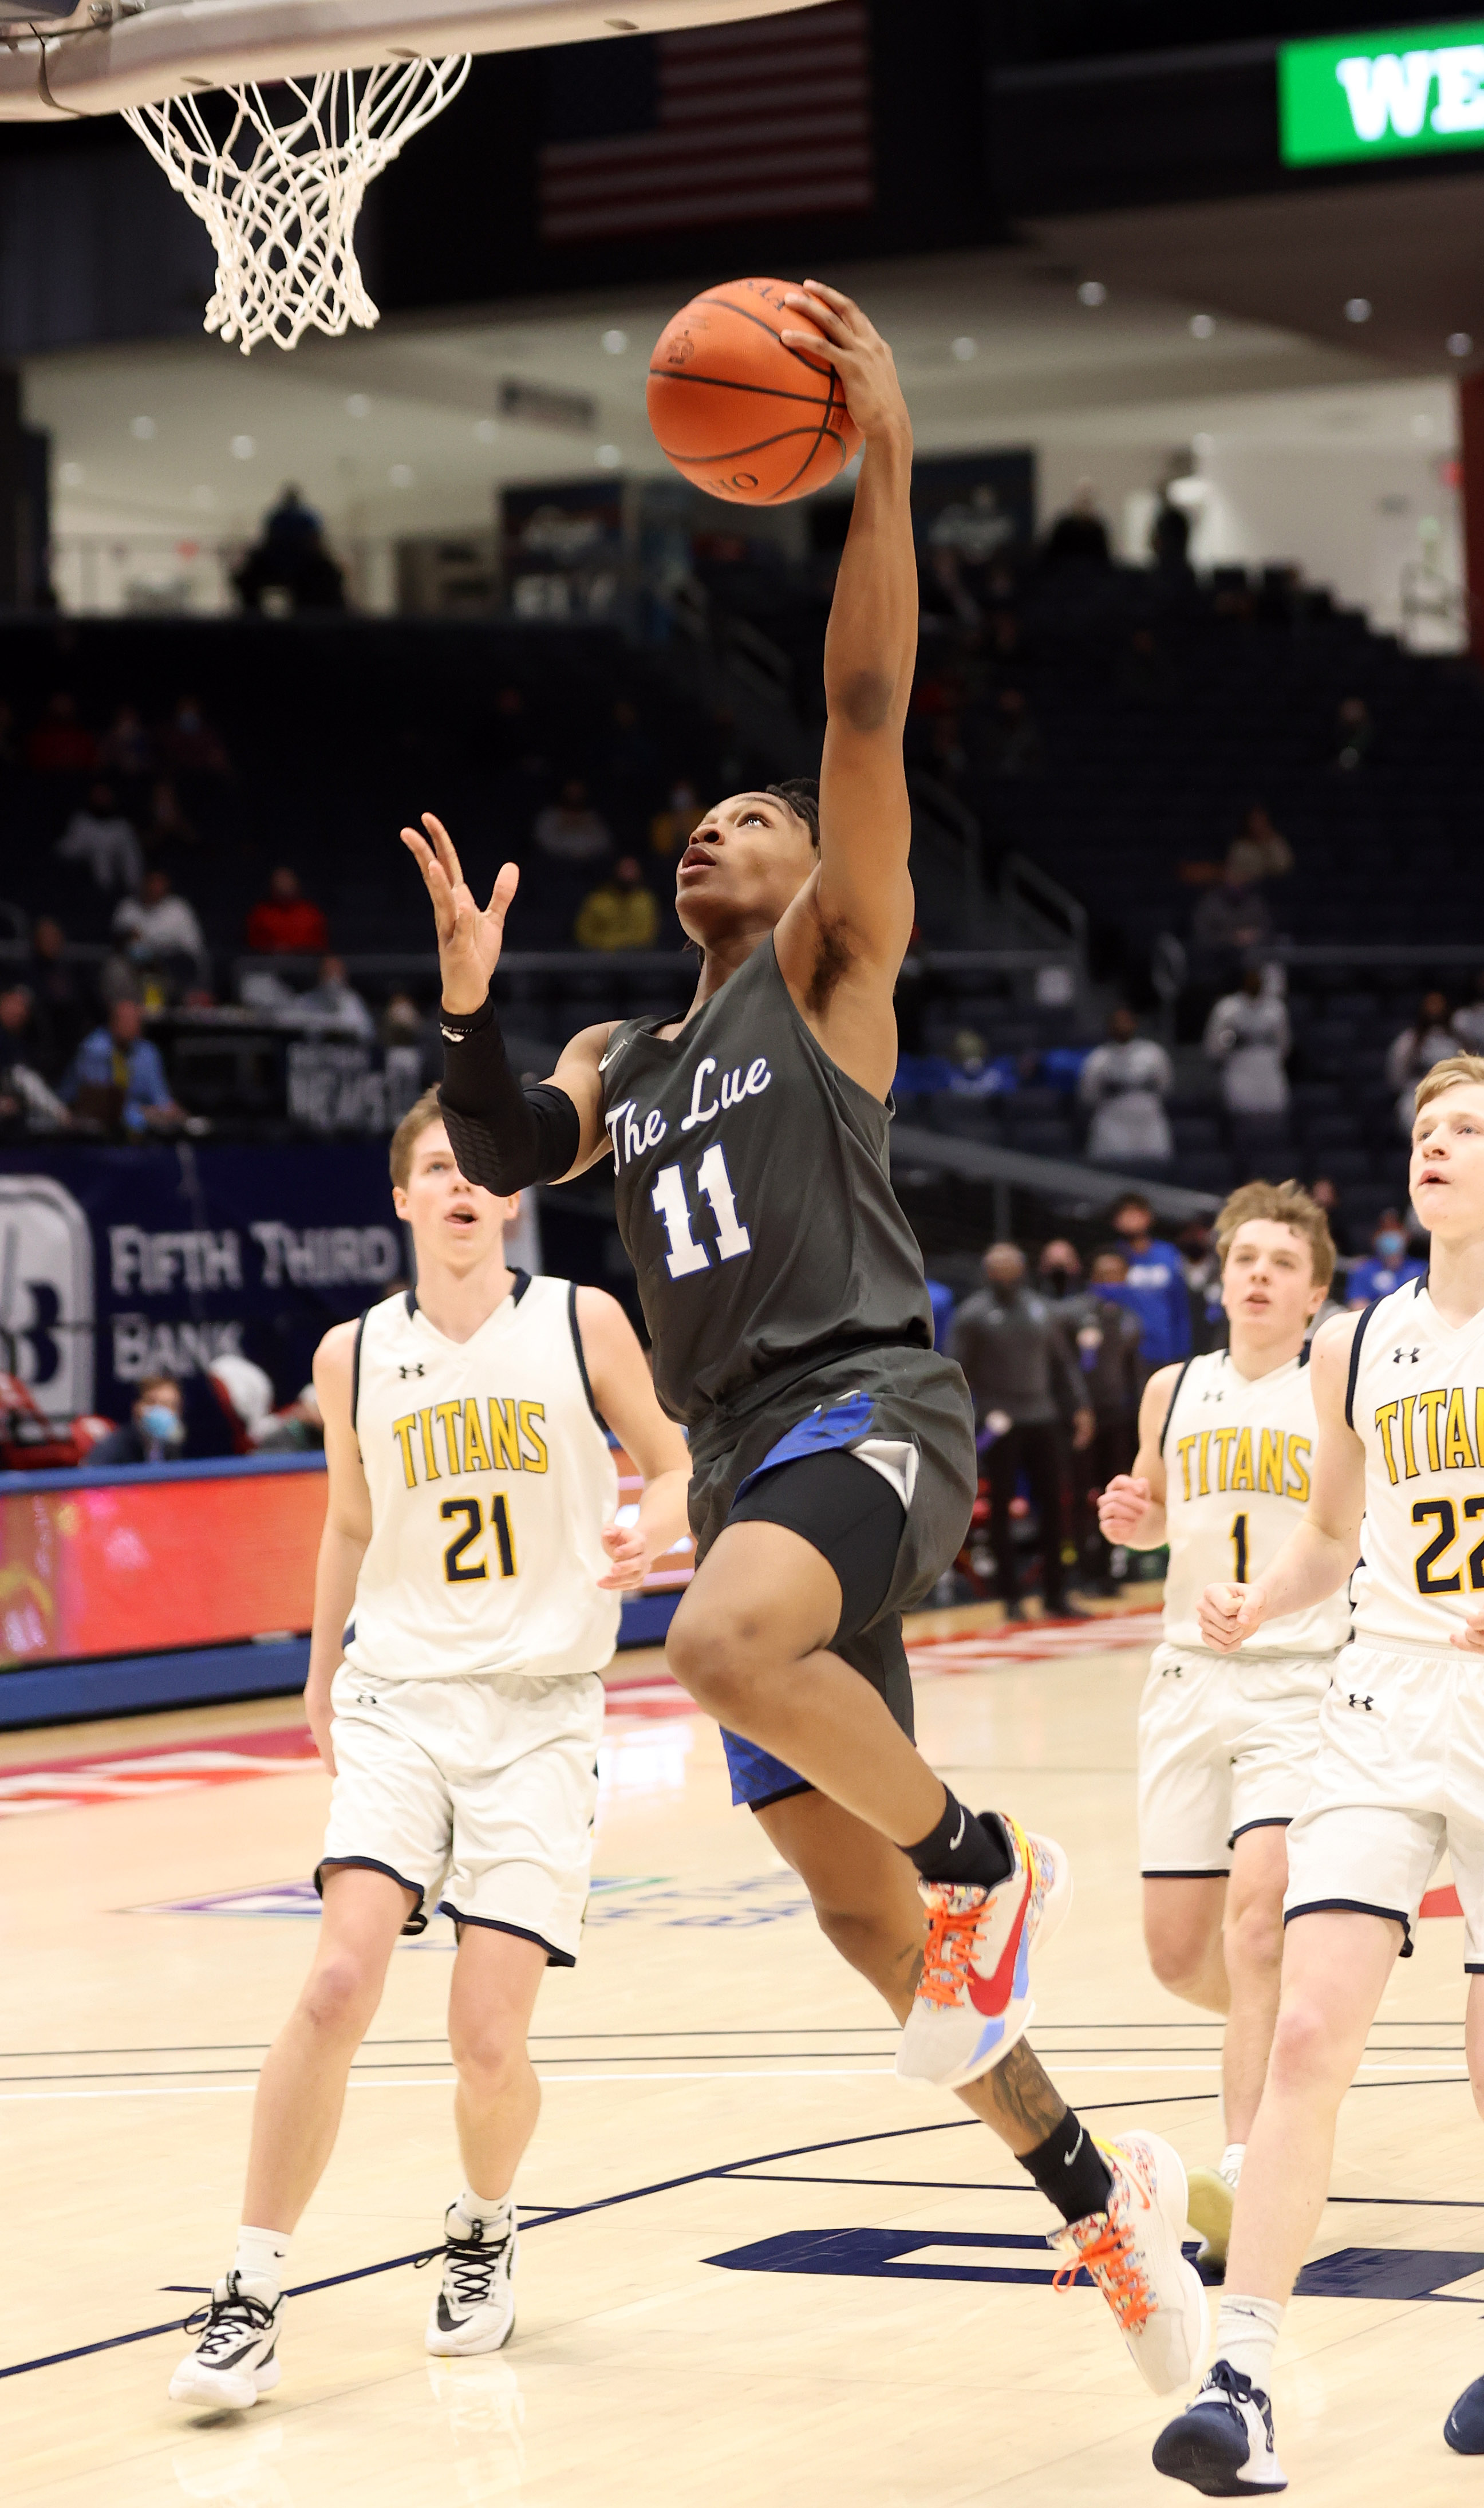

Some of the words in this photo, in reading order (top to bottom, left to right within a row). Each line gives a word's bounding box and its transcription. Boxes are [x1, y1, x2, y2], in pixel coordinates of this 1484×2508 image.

[1335, 44, 1484, 142] WE
[605, 1098, 668, 1177] The
[680, 1055, 772, 1131] Lue
[650, 1141, 752, 1281] 11
[110, 1224, 244, 1295] FIFTH
[250, 1221, 400, 1288] THIRD
[113, 1312, 246, 1383] BANK
[392, 1398, 548, 1488] TITANS
[1177, 1427, 1312, 1501] TITANS
[1375, 1387, 1484, 1485] TITA
[439, 1491, 517, 1583] 21
[1230, 1512, 1249, 1583] 1
